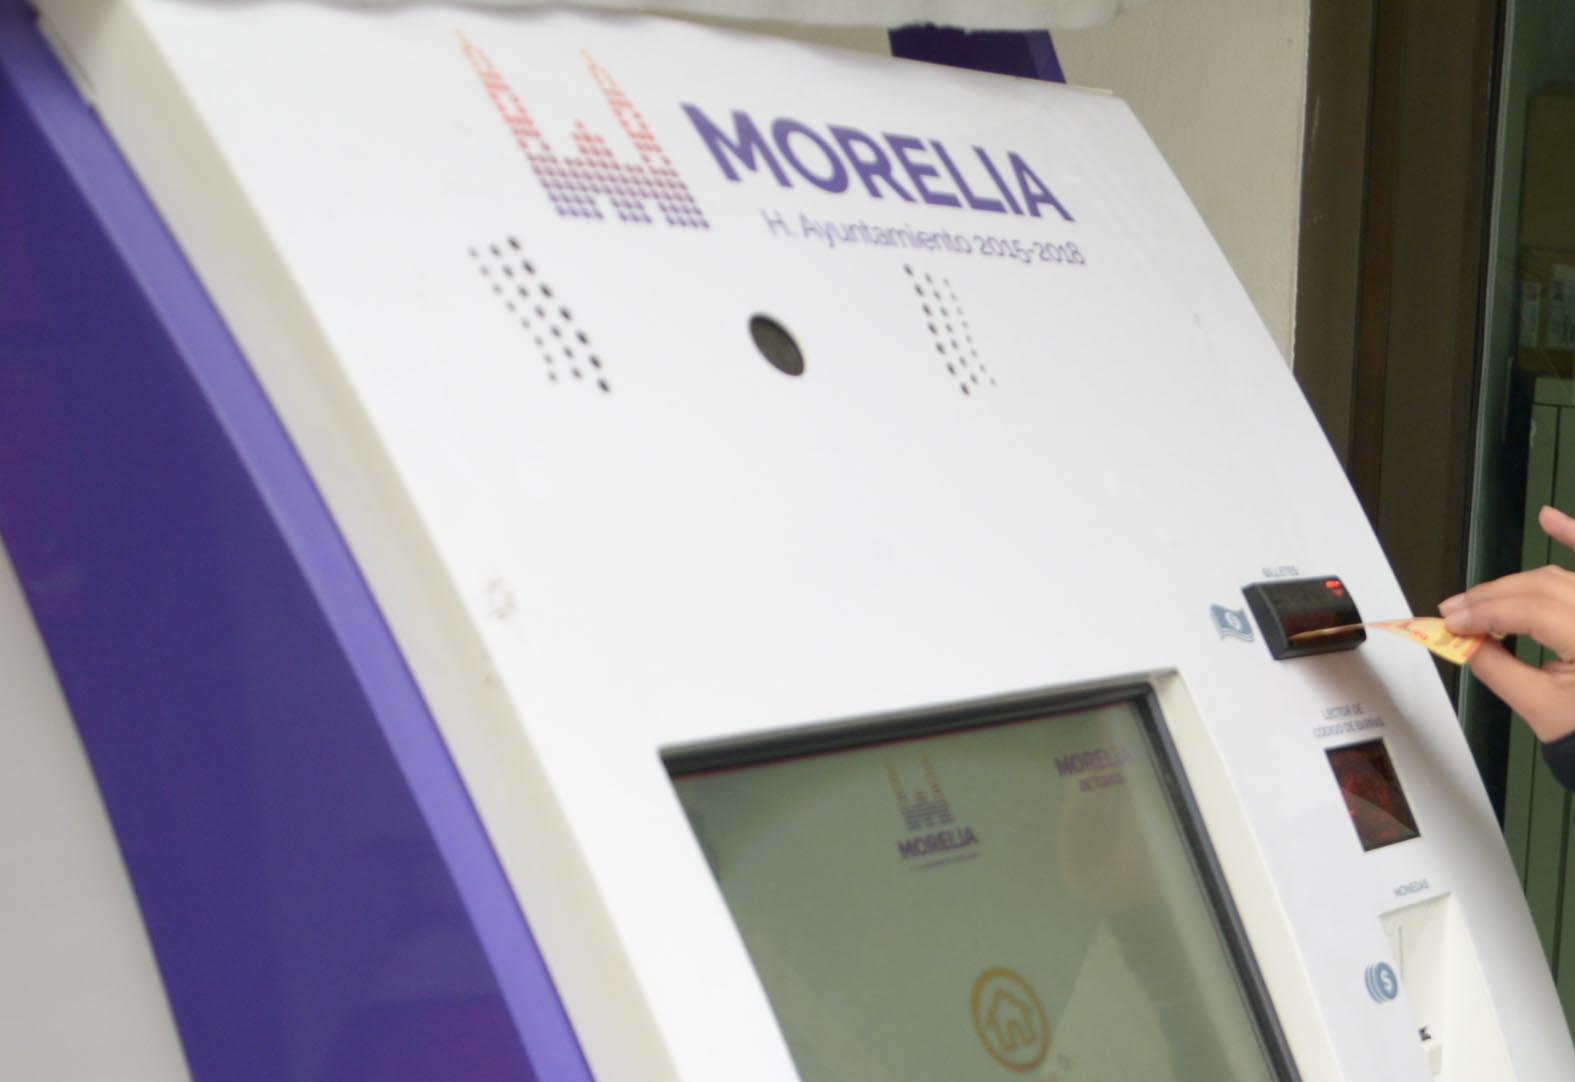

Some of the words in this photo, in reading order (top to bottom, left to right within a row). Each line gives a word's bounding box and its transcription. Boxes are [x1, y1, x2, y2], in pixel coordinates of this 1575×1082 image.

[681, 102, 1077, 222] MORELIA
[759, 207, 797, 239] H.
[799, 212, 972, 251] Ayuntamiento
[974, 236, 1087, 265] 2015-2018
[897, 826, 980, 860] MORELIA
